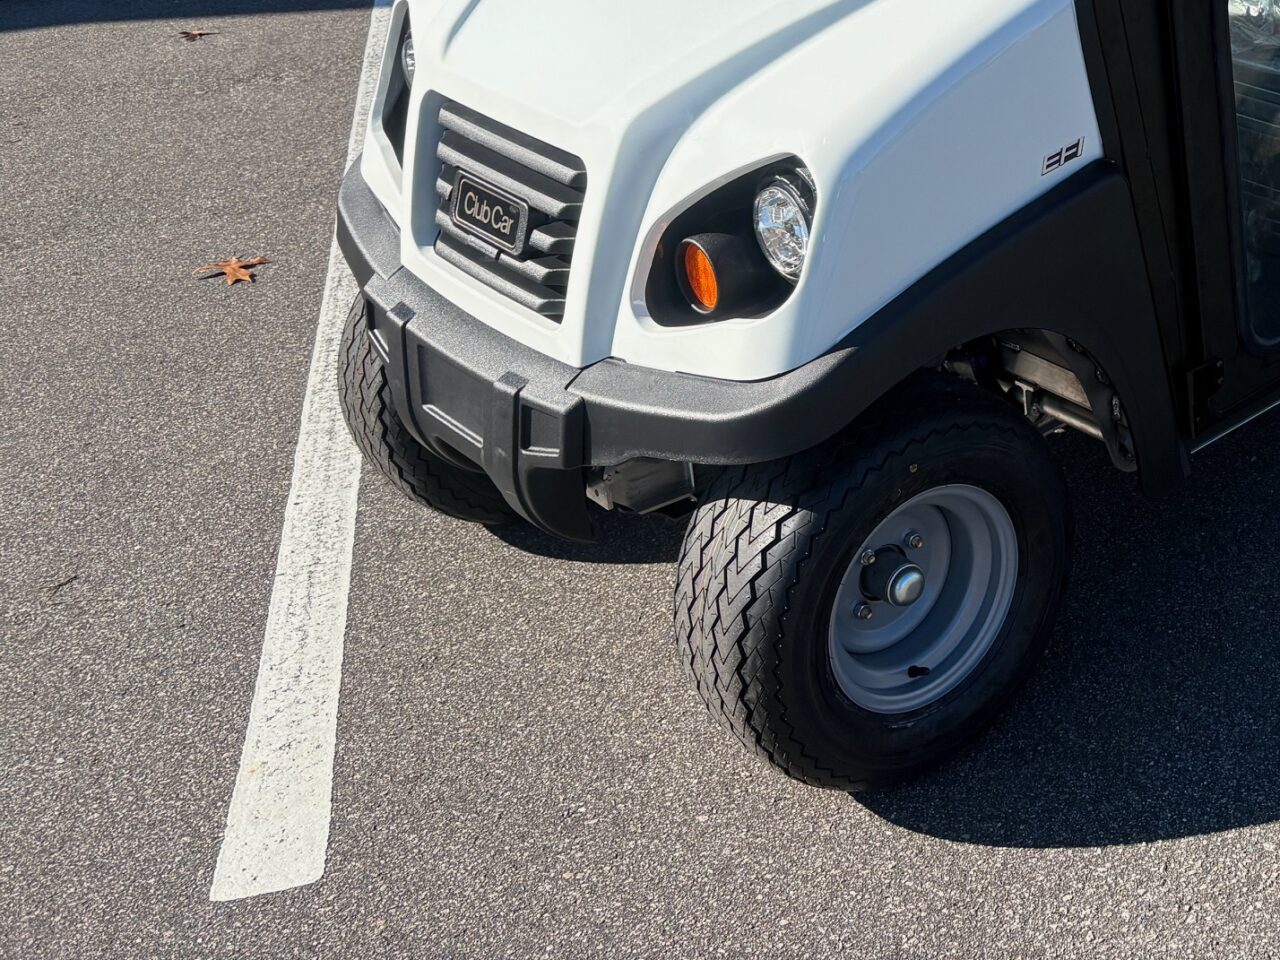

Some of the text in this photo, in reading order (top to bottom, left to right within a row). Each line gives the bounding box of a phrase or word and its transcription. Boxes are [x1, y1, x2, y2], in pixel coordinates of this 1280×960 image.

[1041, 136, 1085, 176] EFI
[464, 191, 514, 235] Club Car
